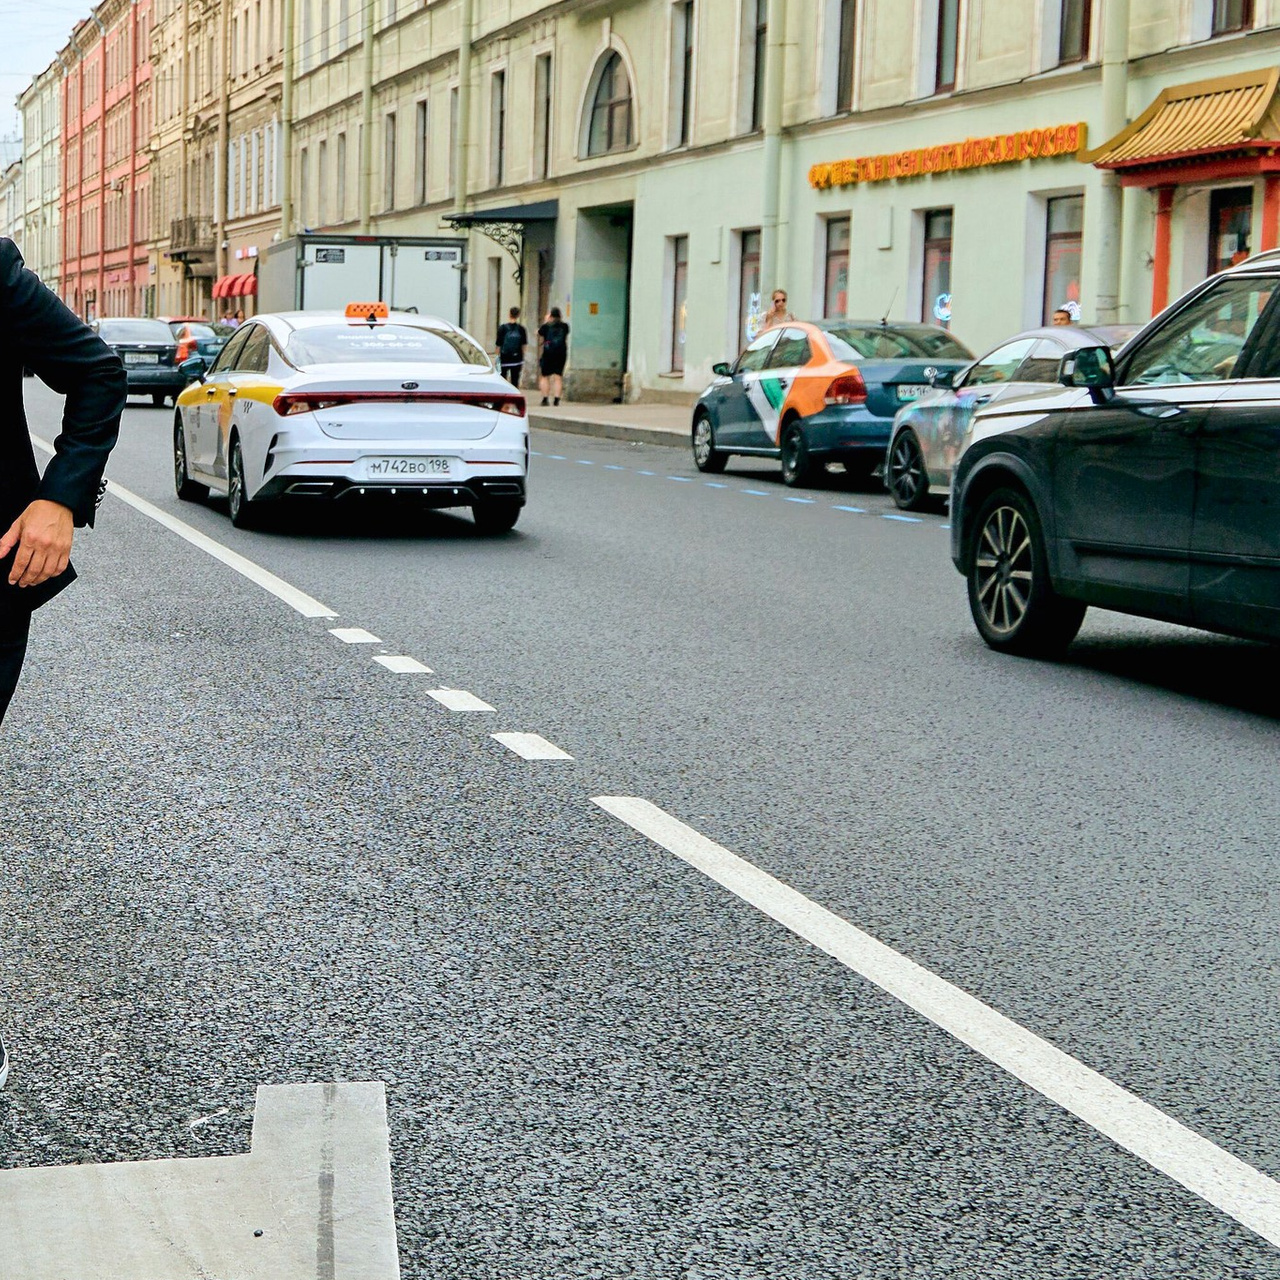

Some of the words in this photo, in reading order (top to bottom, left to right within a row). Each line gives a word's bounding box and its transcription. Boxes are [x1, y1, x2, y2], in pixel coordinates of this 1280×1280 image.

[856, 155, 885, 182] ТАН
[886, 150, 920, 178] ЖЕН
[920, 132, 1017, 172] КИТАЙСКАЯ
[1018, 123, 1082, 160] КУХНЯ
